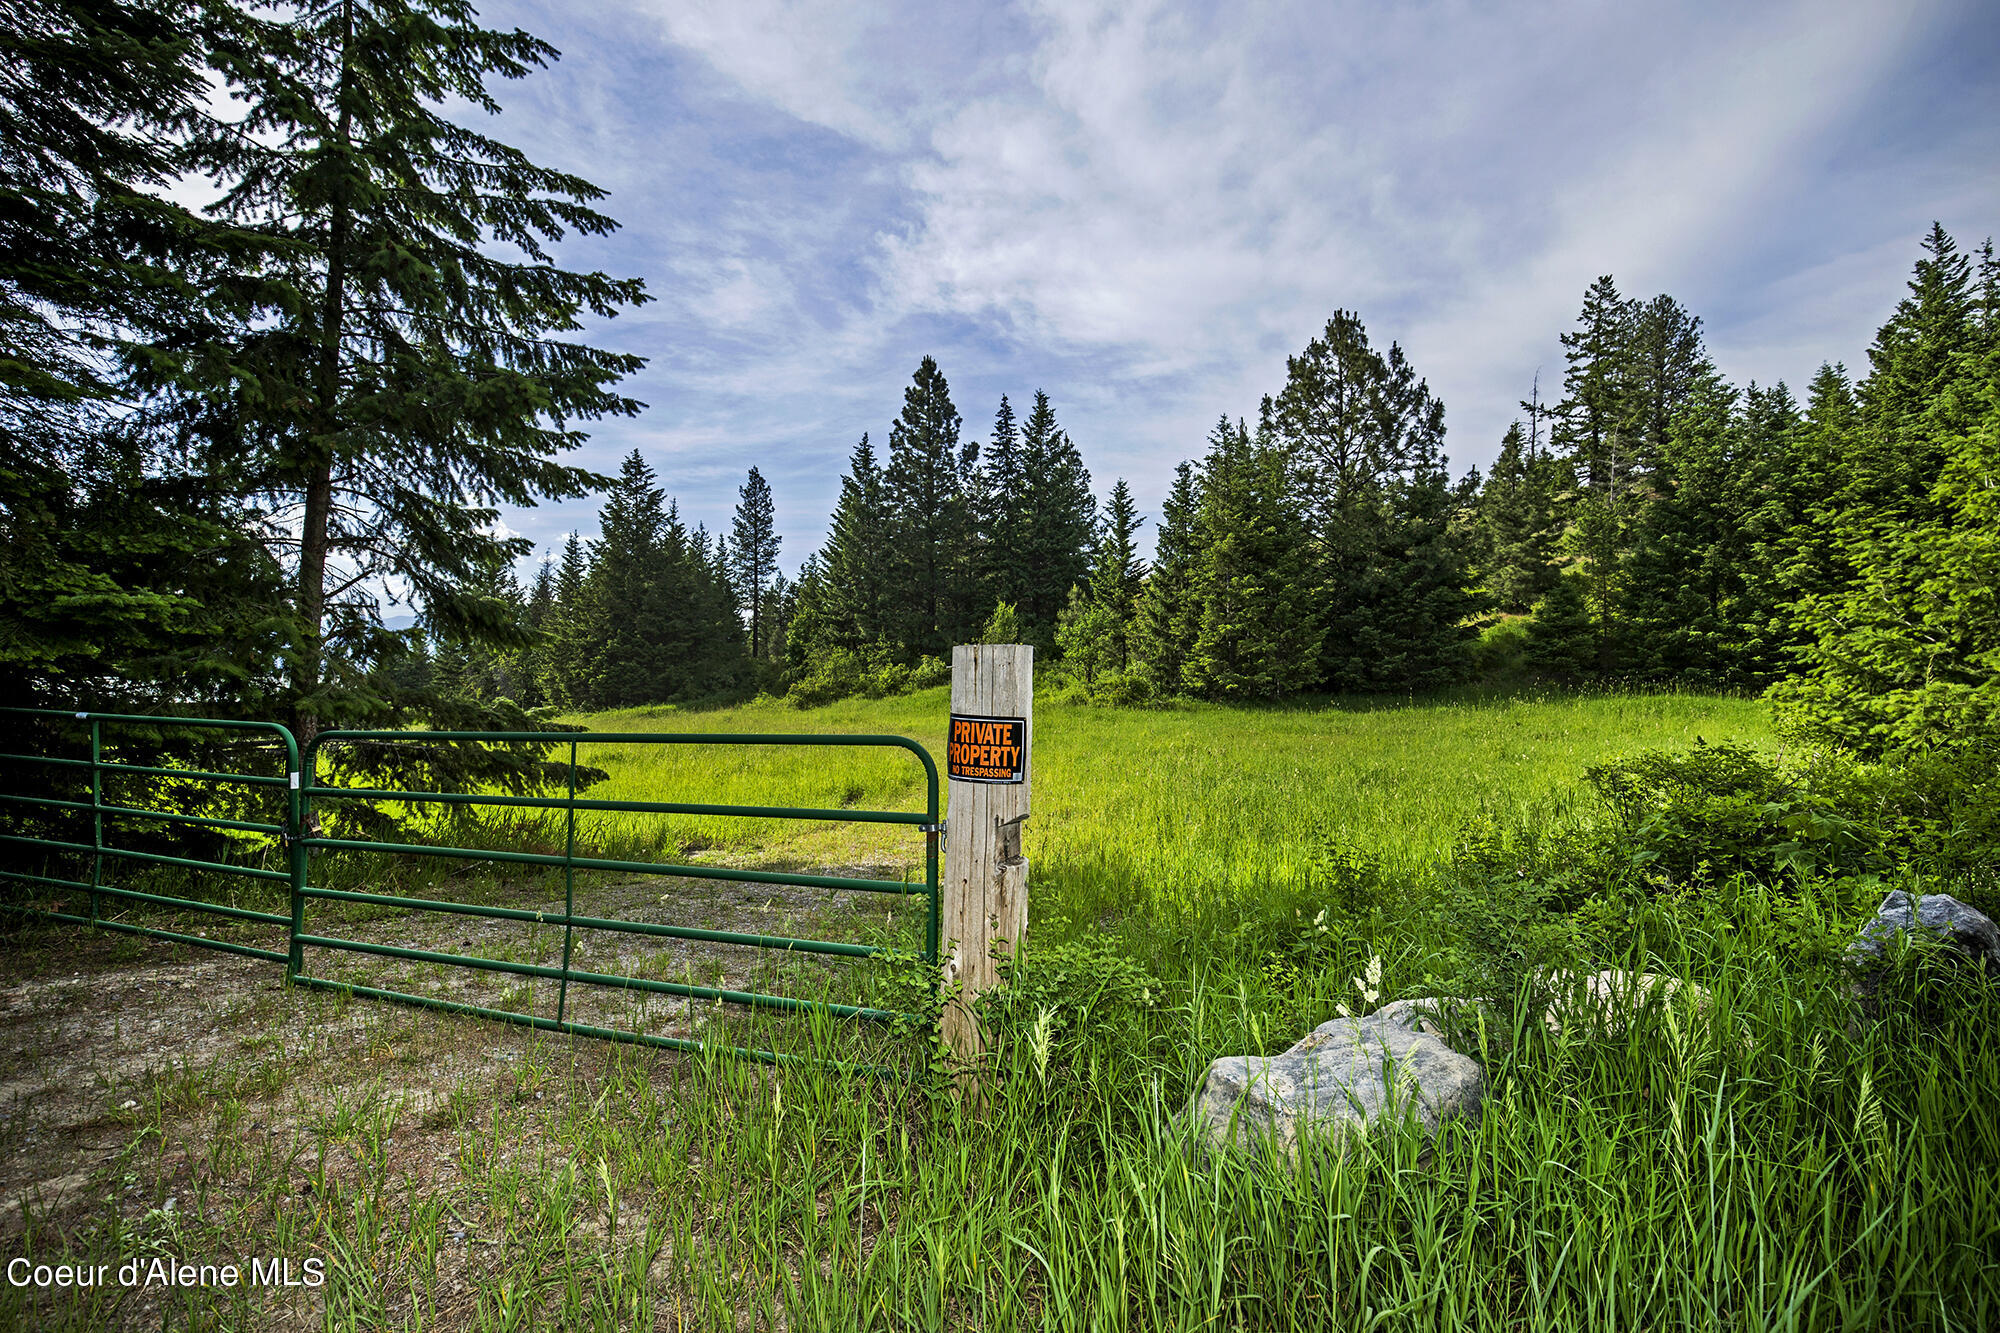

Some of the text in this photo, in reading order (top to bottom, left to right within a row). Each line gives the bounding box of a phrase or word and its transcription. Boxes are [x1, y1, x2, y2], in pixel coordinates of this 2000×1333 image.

[954, 720, 1013, 746] PRIVATE
[949, 742, 1020, 767] PROPERTY
[952, 764, 1012, 778] NO TRESPASSING
